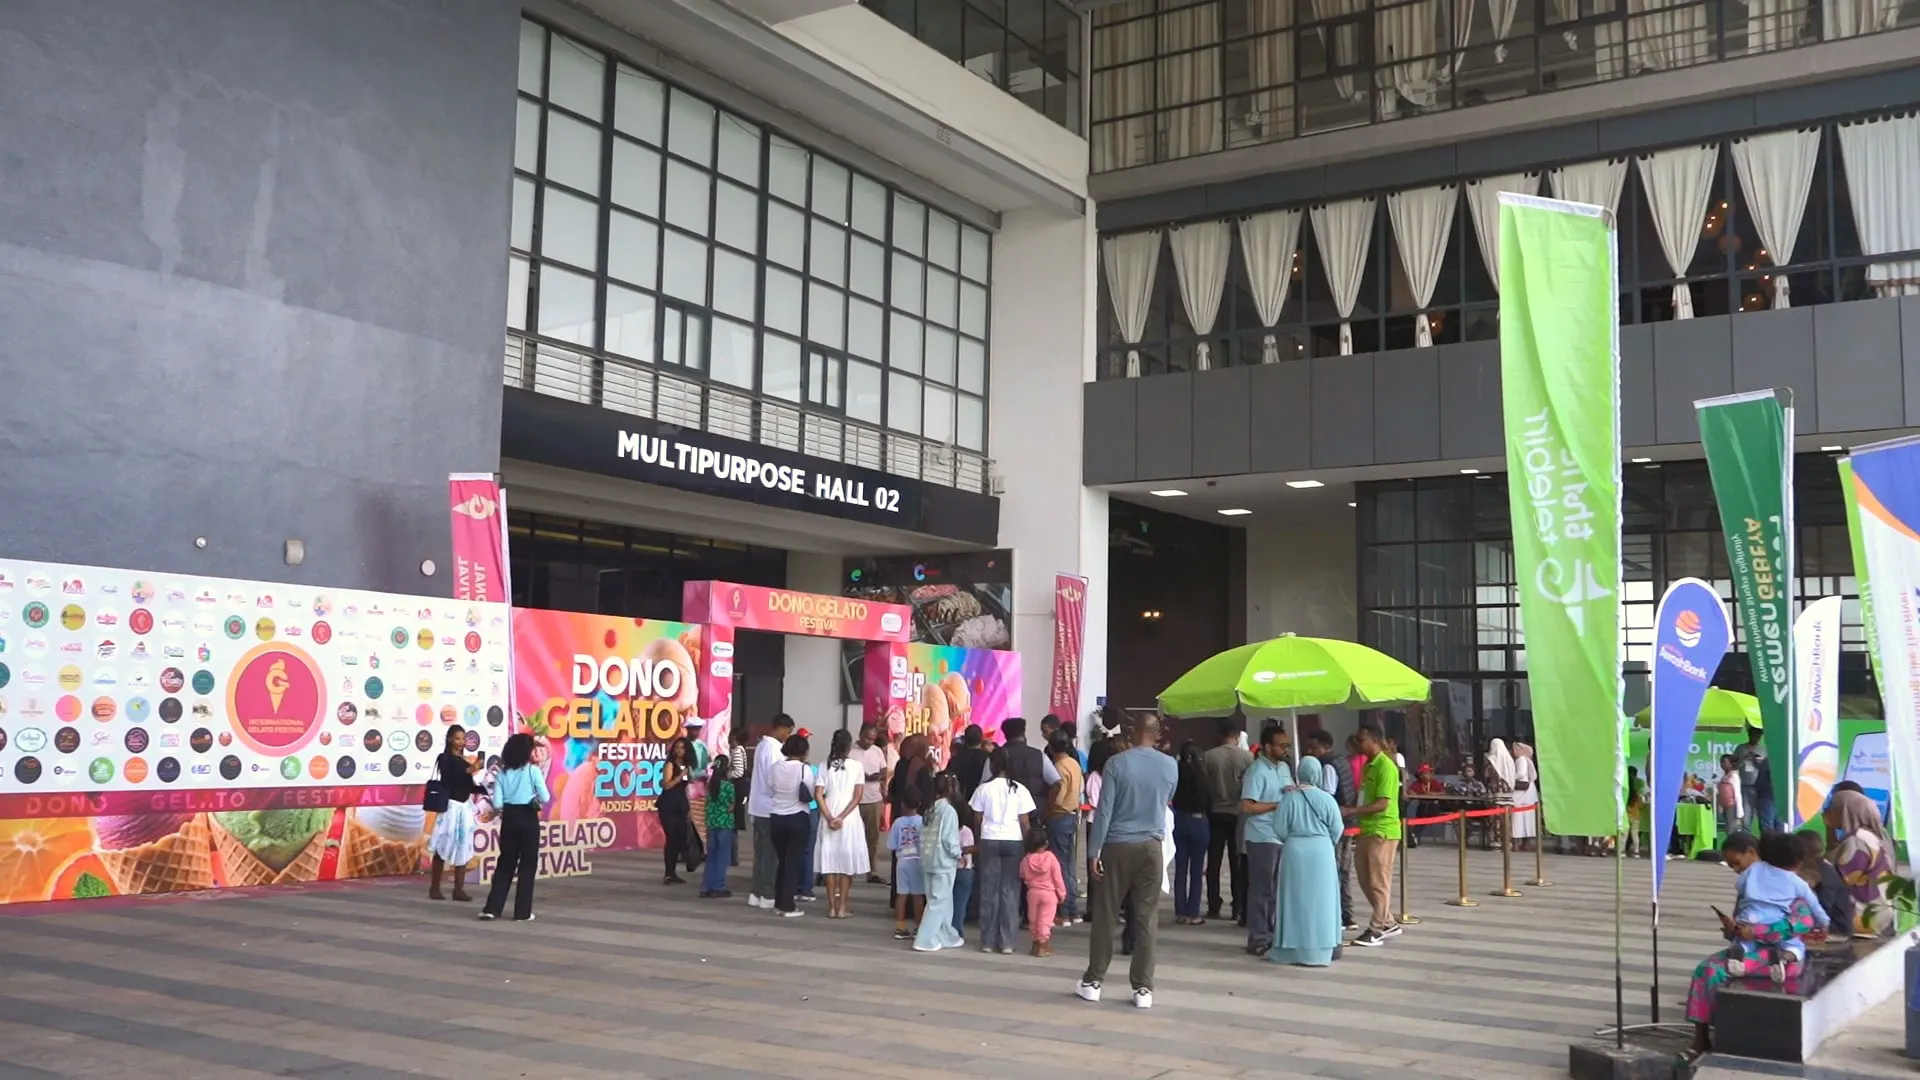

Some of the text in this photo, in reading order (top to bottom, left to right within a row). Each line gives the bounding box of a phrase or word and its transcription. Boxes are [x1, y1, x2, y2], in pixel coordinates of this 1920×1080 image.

[617, 430, 900, 512] MULTIPURPOSE HALL 02
[768, 591, 868, 621] DONO GELATO
[799, 617, 838, 631] FESTIVAL
[572, 653, 681, 698] DONO
[541, 697, 679, 739] GELATO
[26, 794, 108, 815] DONO
[600, 800, 632, 813] ADDIS
